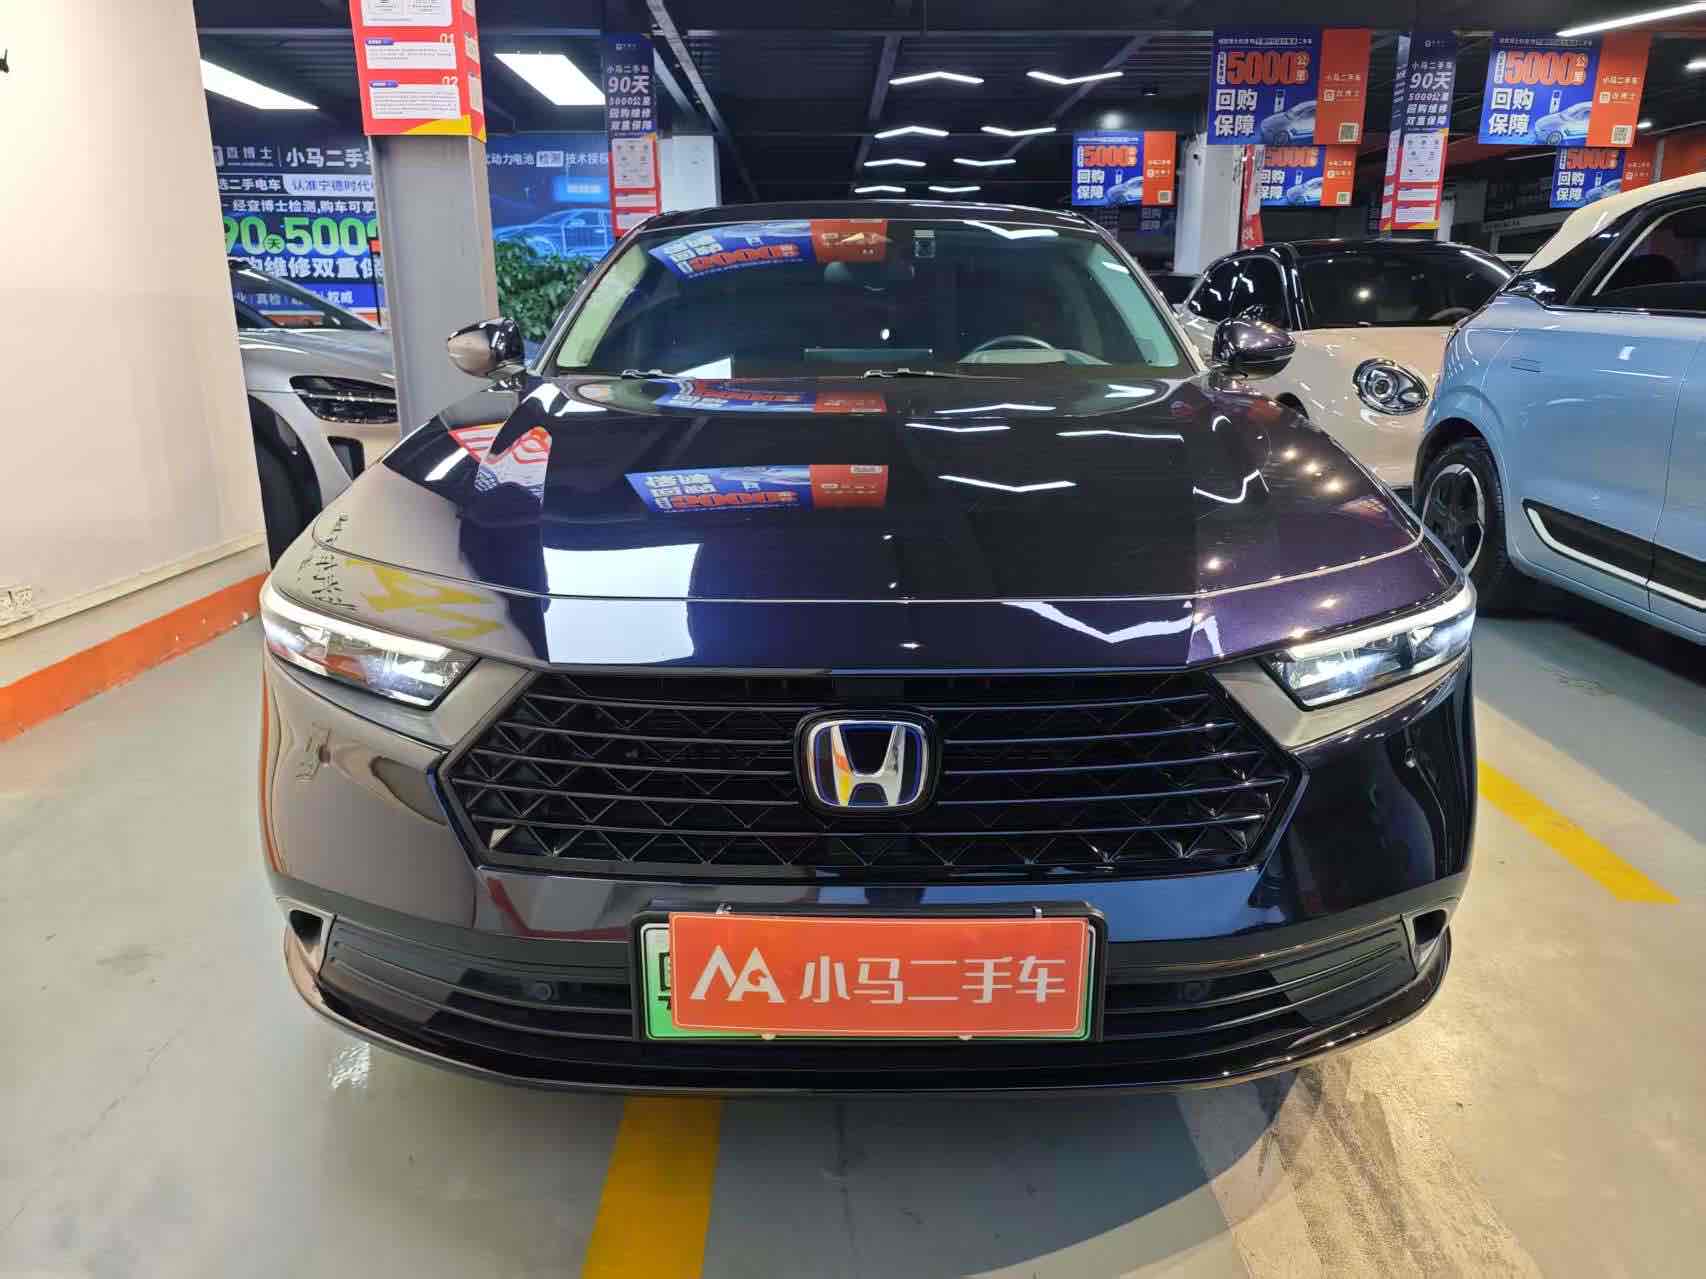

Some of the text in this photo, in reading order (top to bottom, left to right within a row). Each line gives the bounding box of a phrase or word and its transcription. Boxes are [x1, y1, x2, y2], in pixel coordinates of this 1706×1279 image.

[608, 76, 649, 94] 90天
[1409, 72, 1453, 89] 90天
[1216, 88, 1258, 112] 回购
[1491, 88, 1535, 111] 回购
[1215, 114, 1255, 137] 保障
[1488, 113, 1530, 137] 保障
[1077, 169, 1104, 184] 回购
[1558, 171, 1585, 186] 回购
[1077, 185, 1104, 200] 保障
[1557, 187, 1583, 201] 保障
[799, 954, 1067, 1004] 小马二手车
